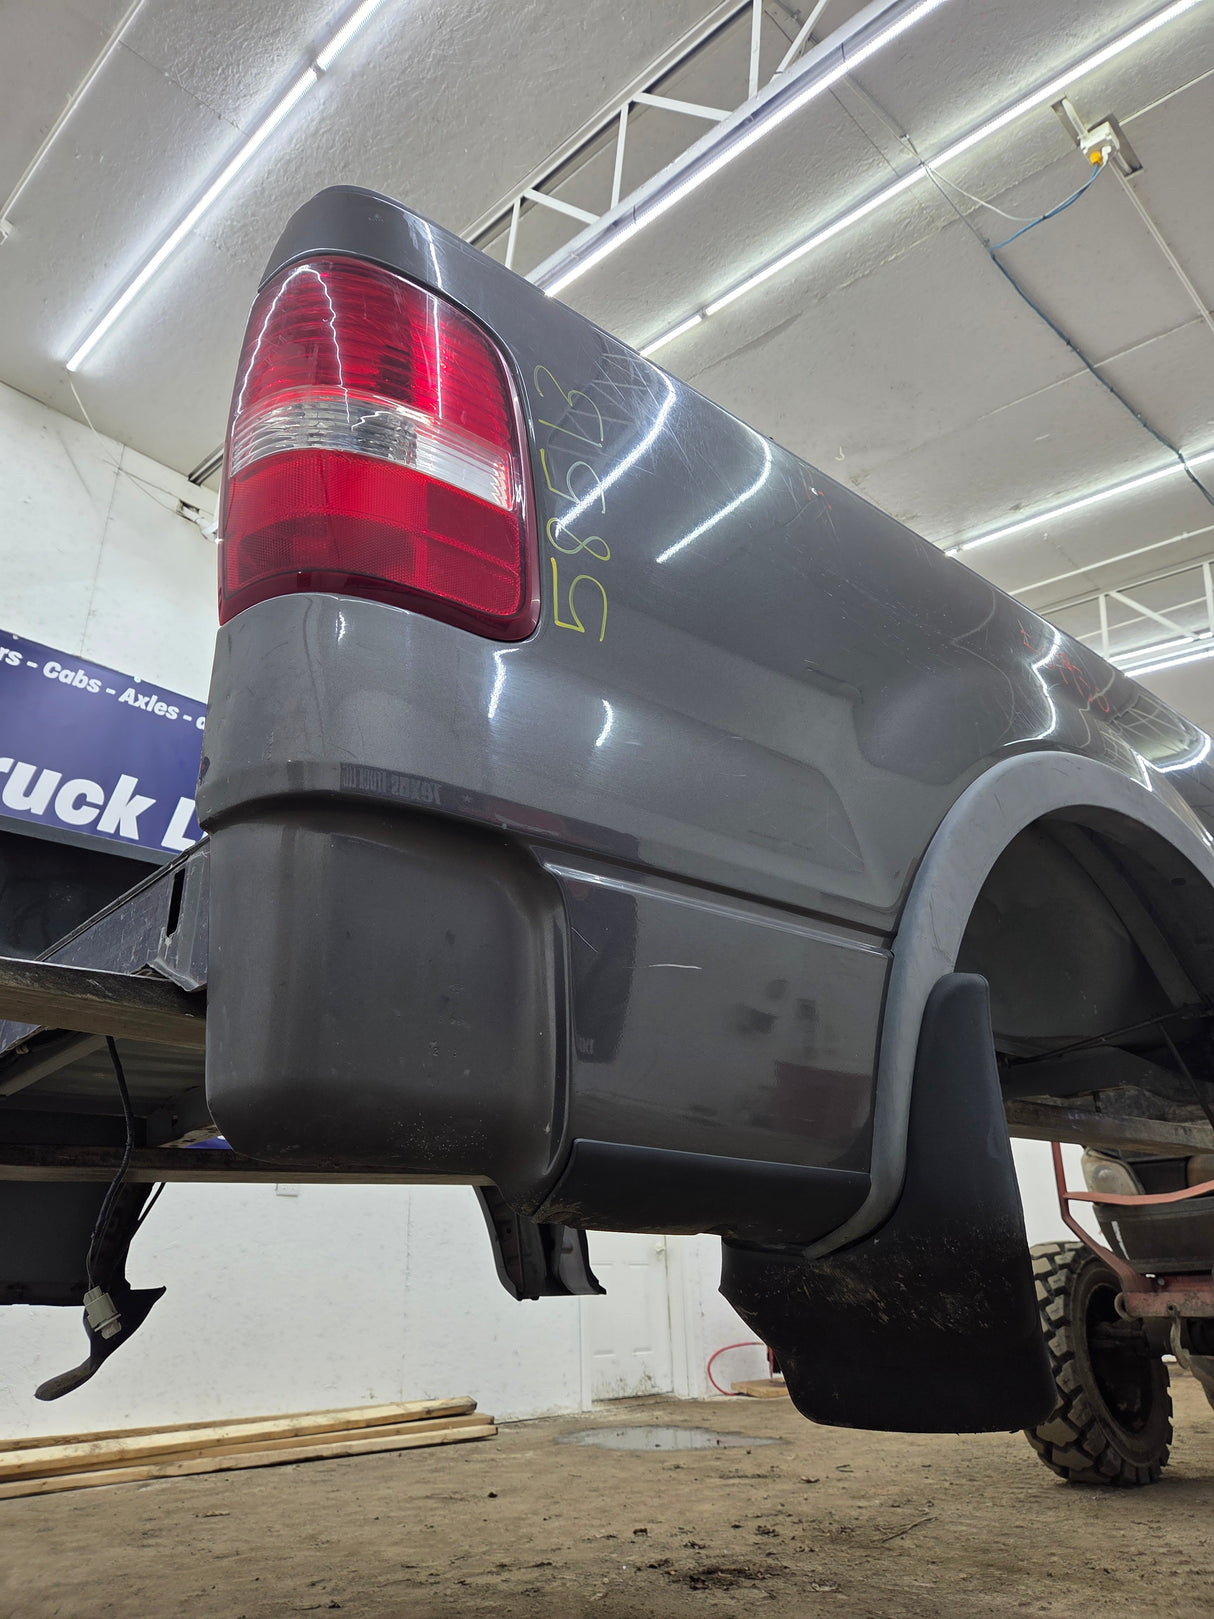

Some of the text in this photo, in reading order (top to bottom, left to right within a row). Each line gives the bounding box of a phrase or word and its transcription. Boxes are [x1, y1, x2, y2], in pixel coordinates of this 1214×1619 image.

[534, 364, 610, 642] 58513
[42, 661, 102, 694] Cabs
[118, 687, 180, 720] Axles
